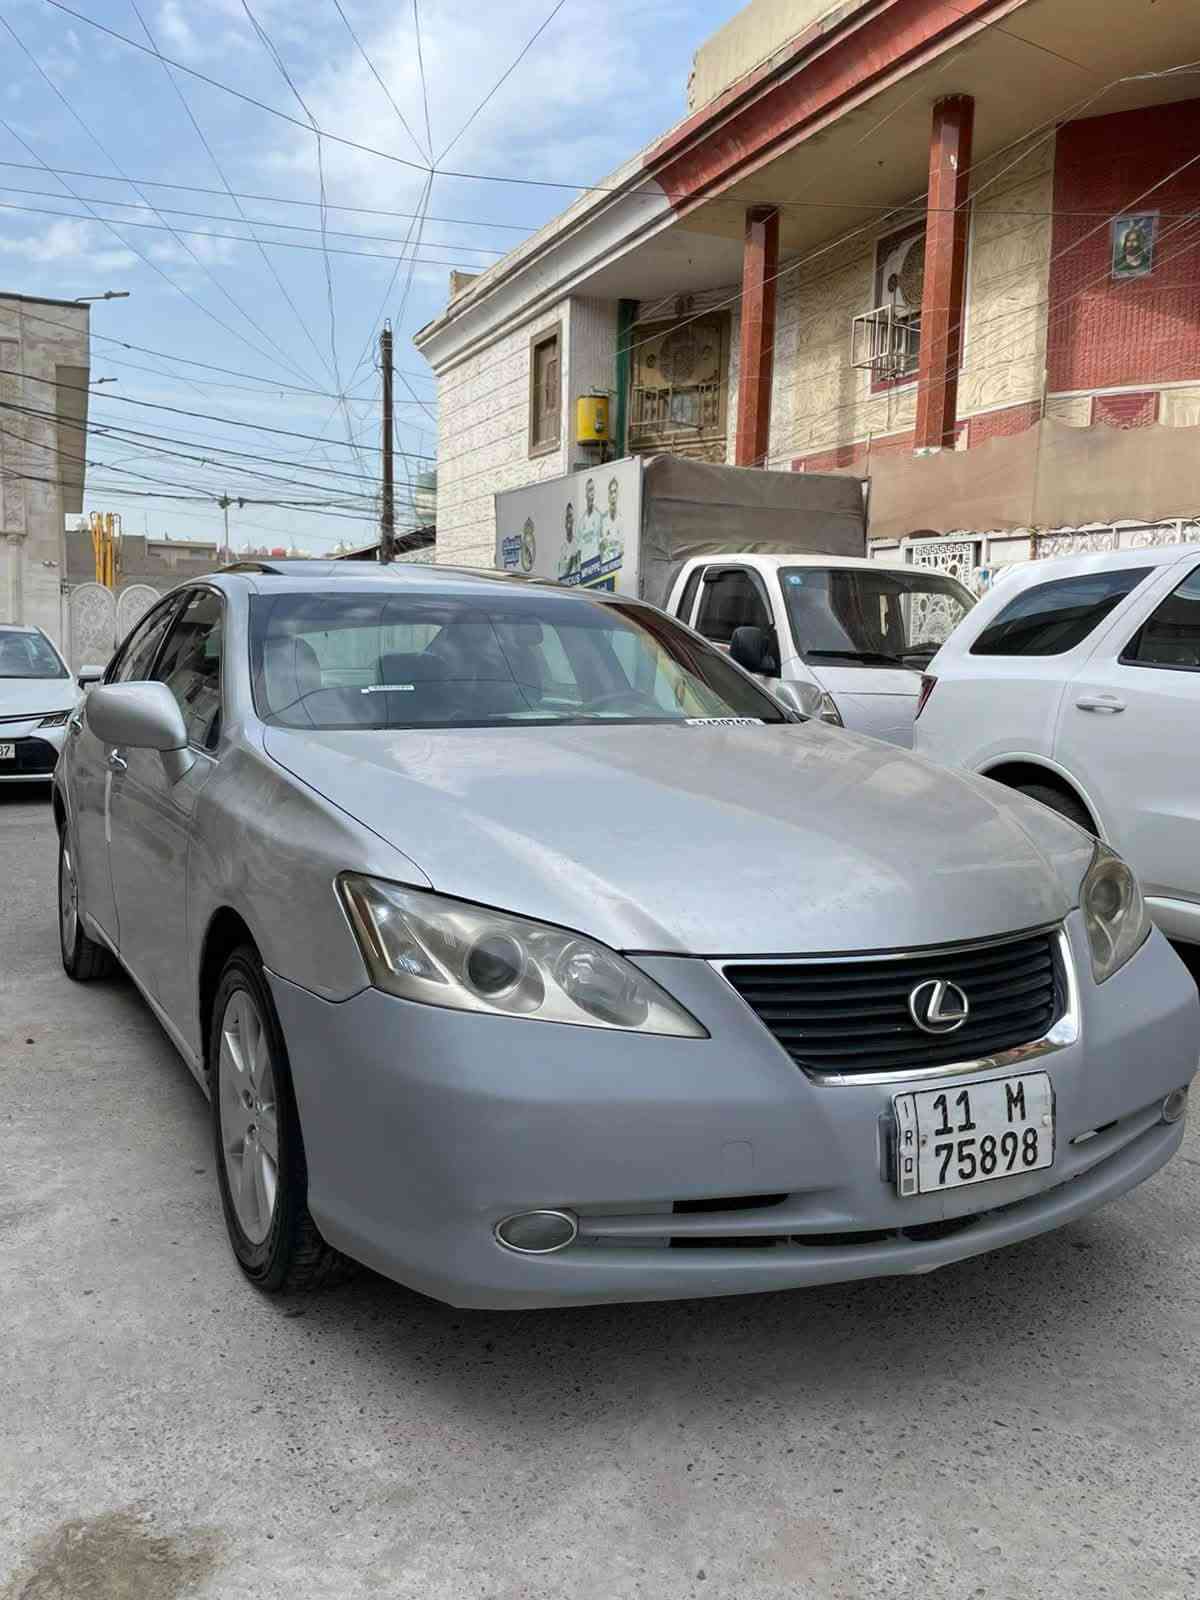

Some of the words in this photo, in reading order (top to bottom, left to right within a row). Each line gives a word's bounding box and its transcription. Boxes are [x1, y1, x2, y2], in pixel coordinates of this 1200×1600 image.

[933, 1090, 976, 1136] 11
[1005, 1081, 1026, 1122] M
[935, 1127, 1038, 1185] 75898
